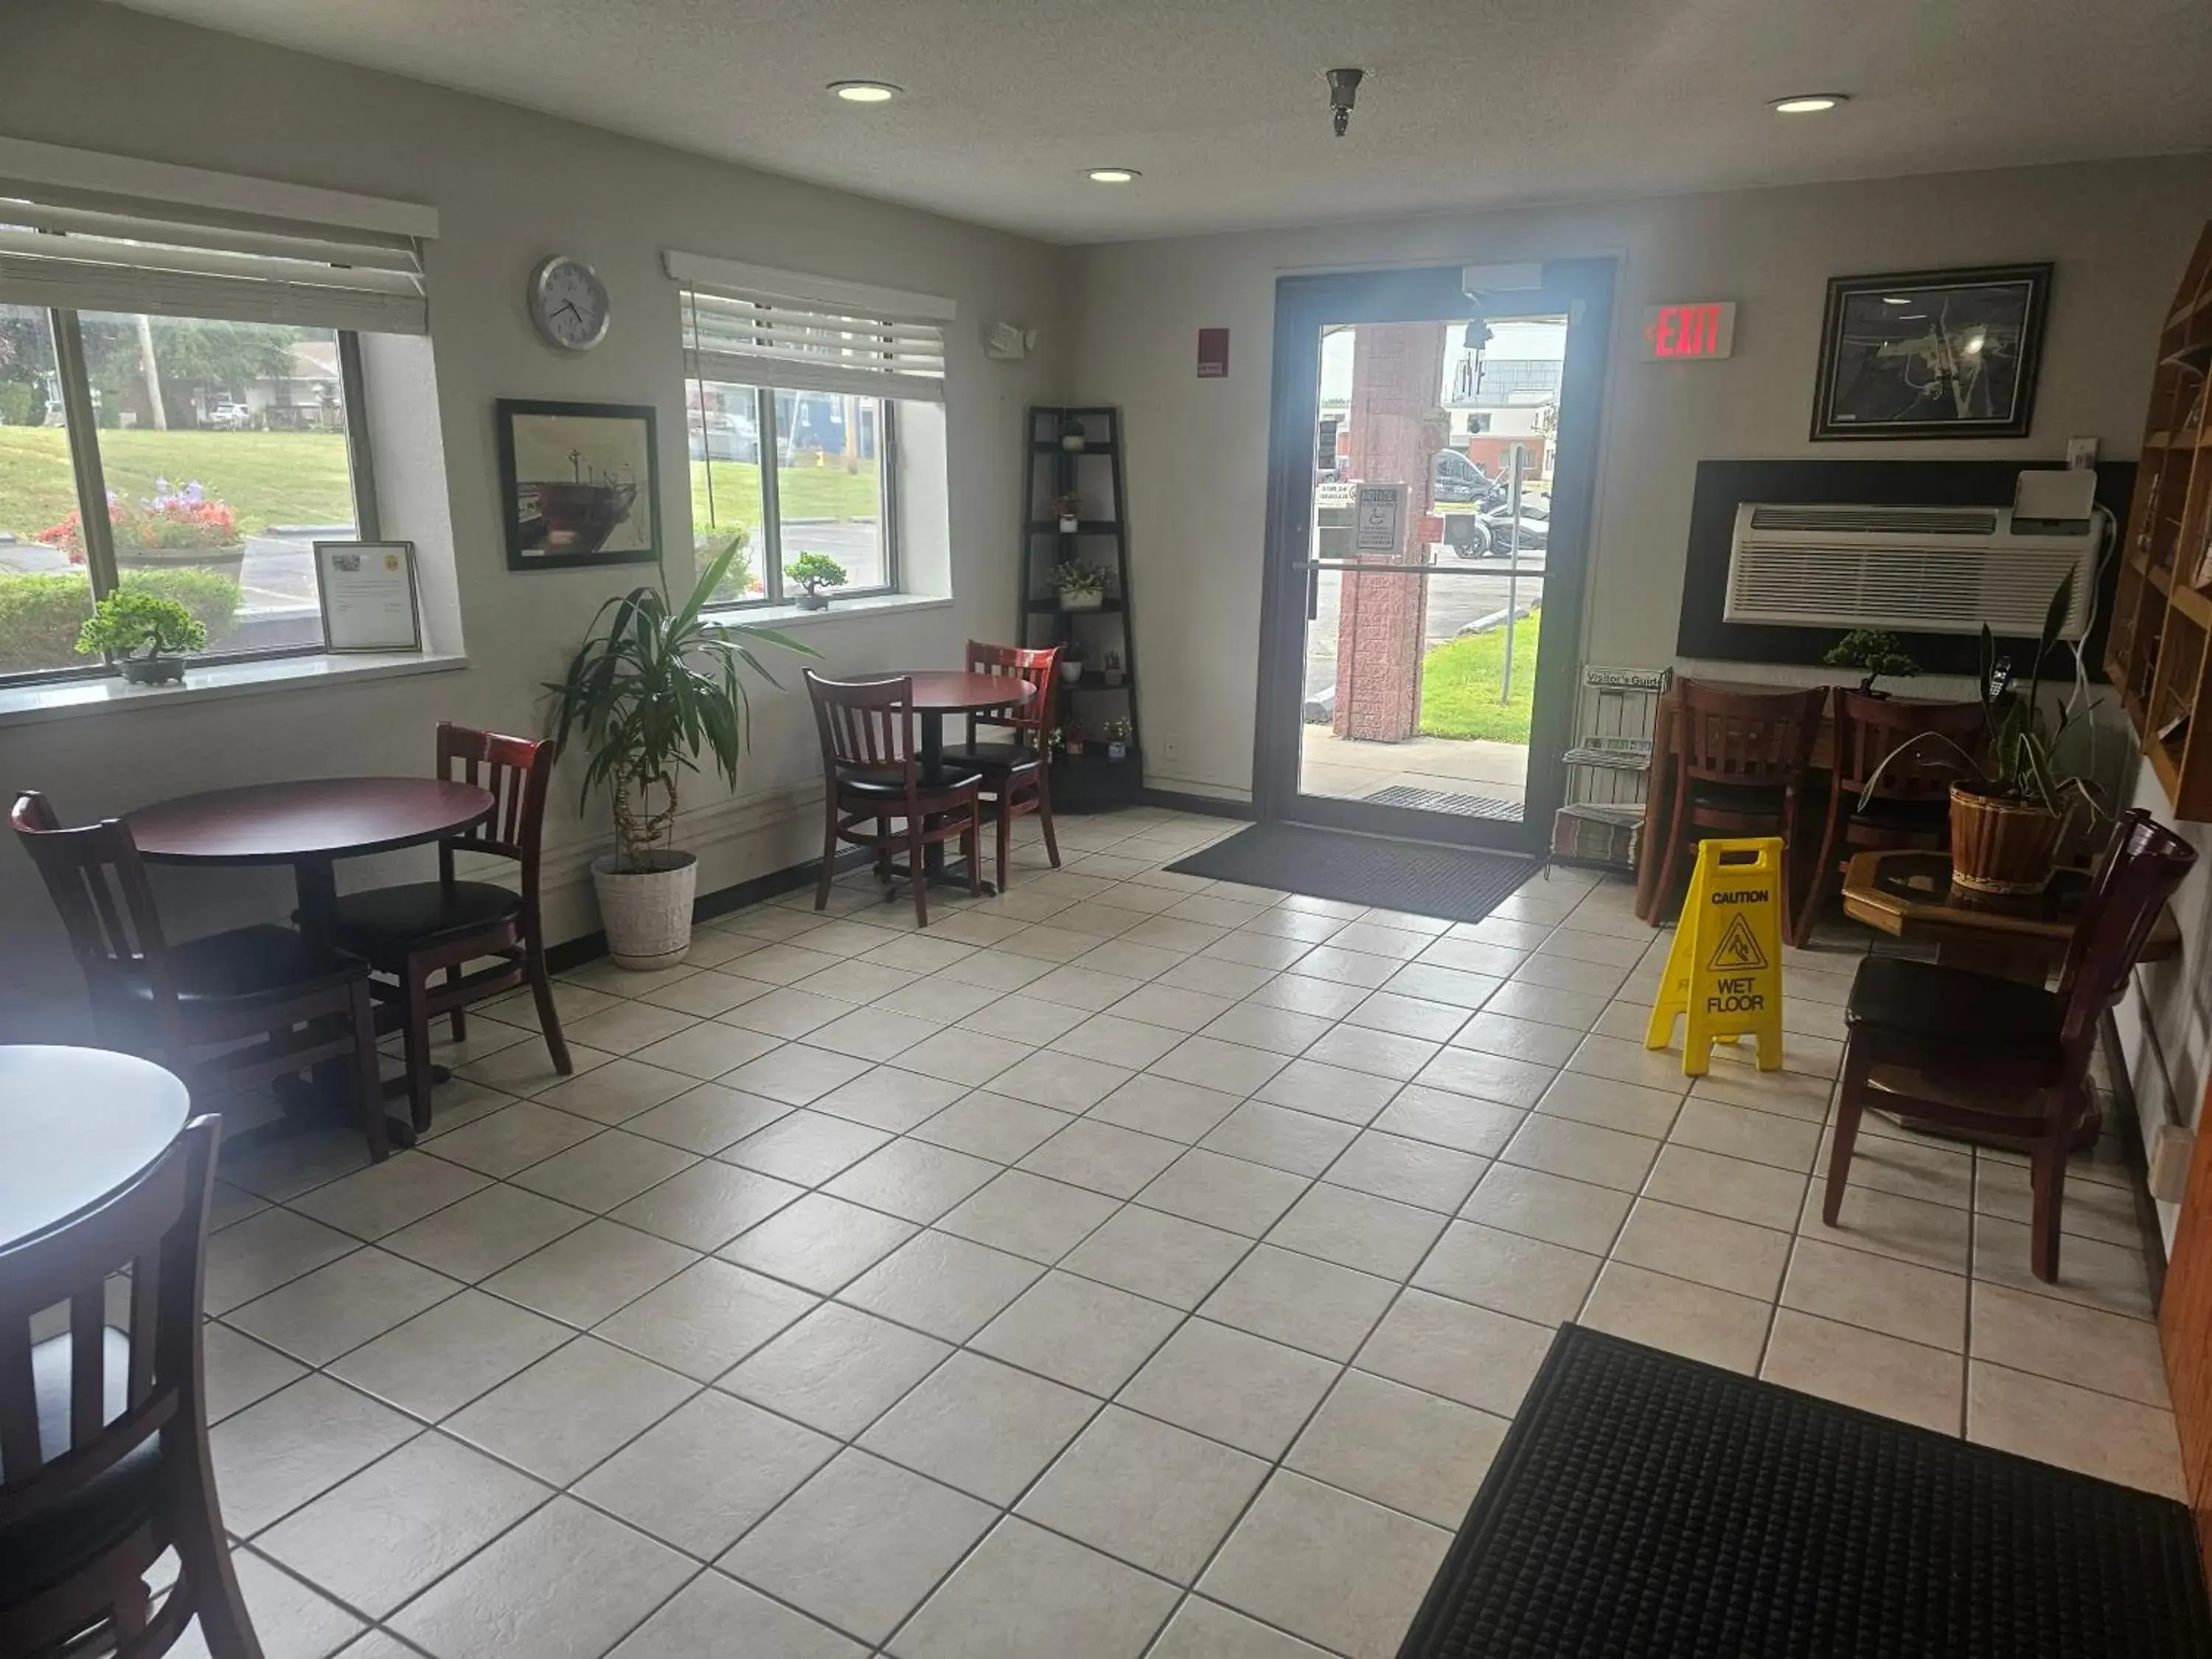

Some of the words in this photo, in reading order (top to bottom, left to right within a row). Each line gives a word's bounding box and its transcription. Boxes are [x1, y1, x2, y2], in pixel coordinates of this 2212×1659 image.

[1655, 305, 1722, 355] EXIT
[1588, 672, 1629, 683] Visitor's
[1711, 890, 1768, 904] CAUTION
[1718, 977, 1756, 994] WET
[1708, 995, 1764, 1013] FLOOR
